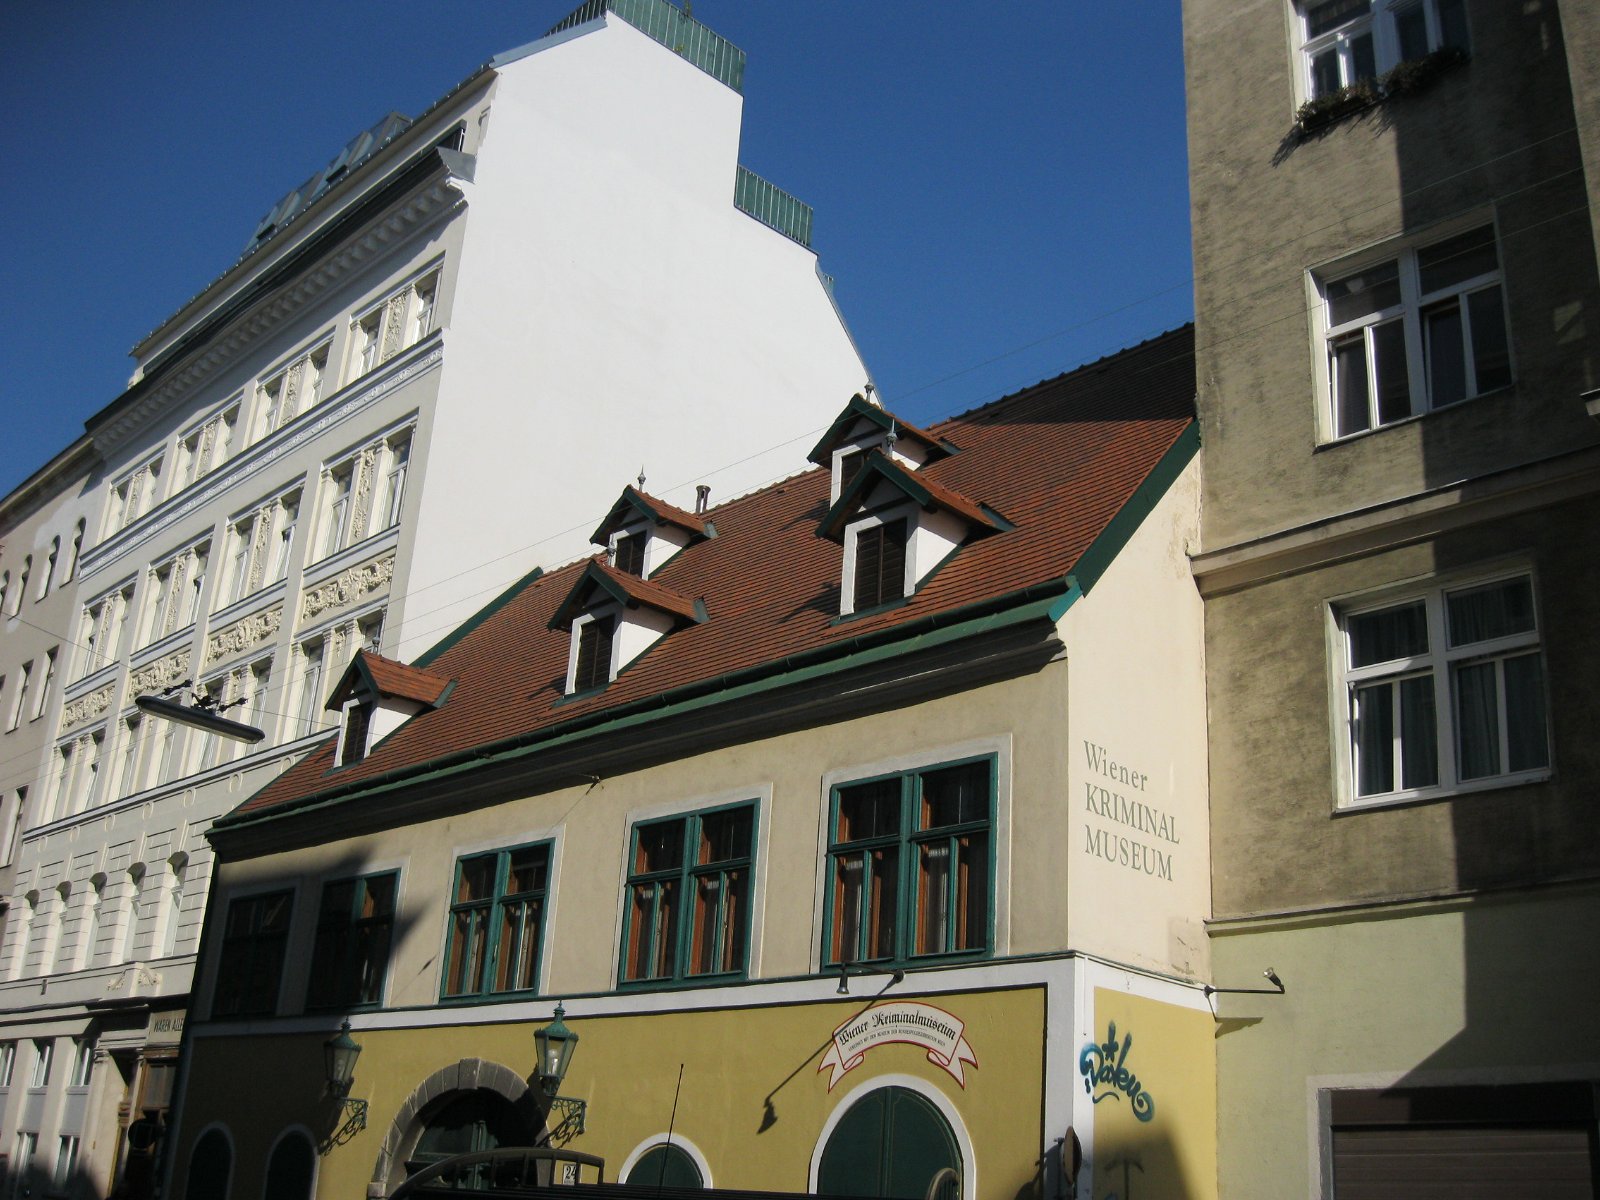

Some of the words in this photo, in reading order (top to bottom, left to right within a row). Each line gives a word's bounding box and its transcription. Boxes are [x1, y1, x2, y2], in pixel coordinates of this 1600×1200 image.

[1083, 740, 1148, 791] Wiener
[1084, 782, 1180, 844] KRIMINAL
[1084, 824, 1173, 881] MUSEUM
[839, 1022, 869, 1046] Wiener
[872, 1010, 957, 1041] Kriminalmuseum
